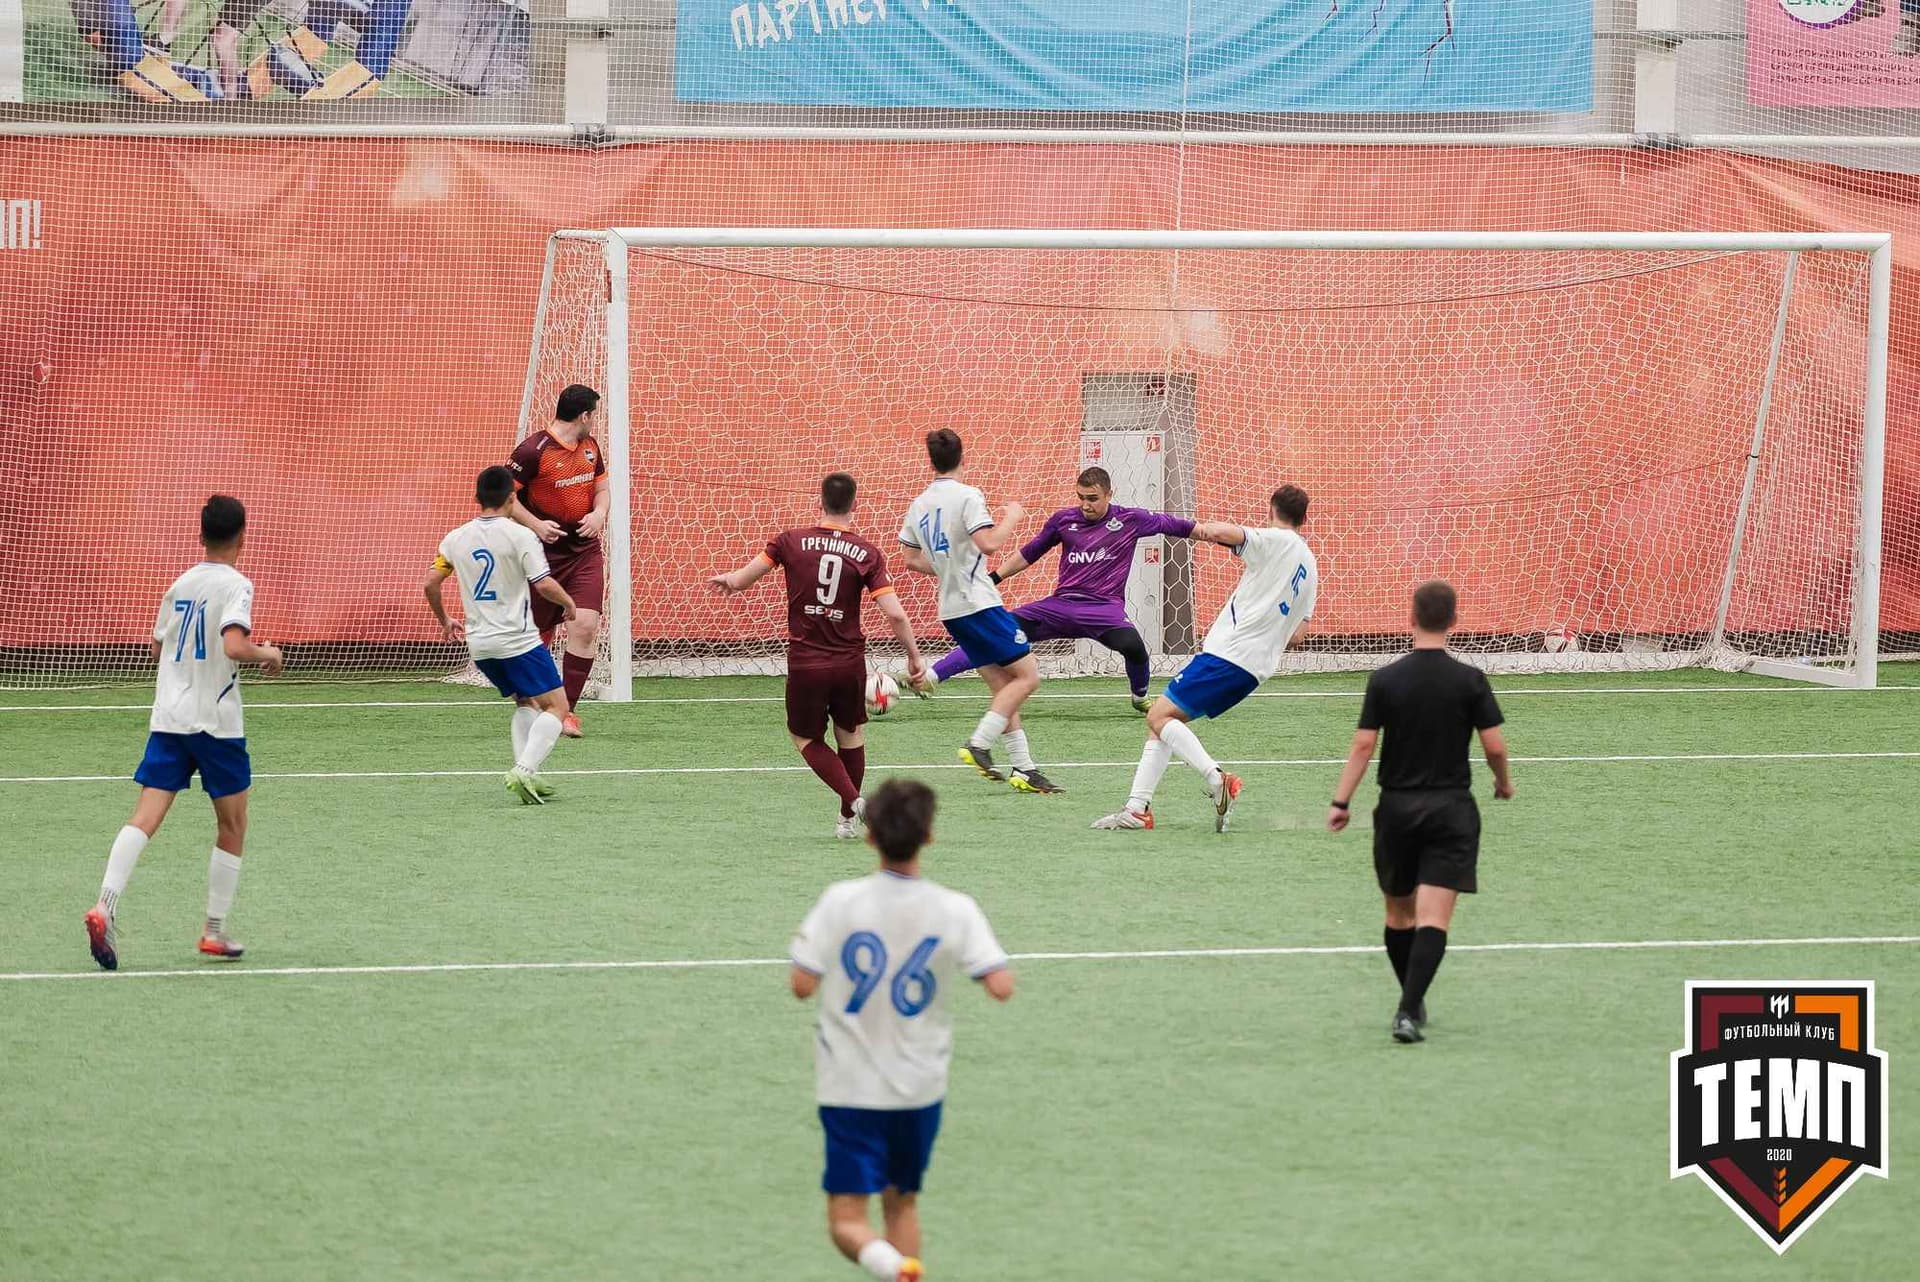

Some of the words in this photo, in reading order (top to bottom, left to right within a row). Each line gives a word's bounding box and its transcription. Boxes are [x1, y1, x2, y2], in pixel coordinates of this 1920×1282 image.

[0, 198, 41, 250] П!
[801, 536, 868, 563] ГРЕЧНИКОВ
[919, 507, 950, 561] 14
[1068, 551, 1095, 564] GNV
[471, 547, 497, 602] 2
[816, 553, 843, 606] 9
[175, 599, 207, 662] 71
[841, 930, 940, 1017] 96
